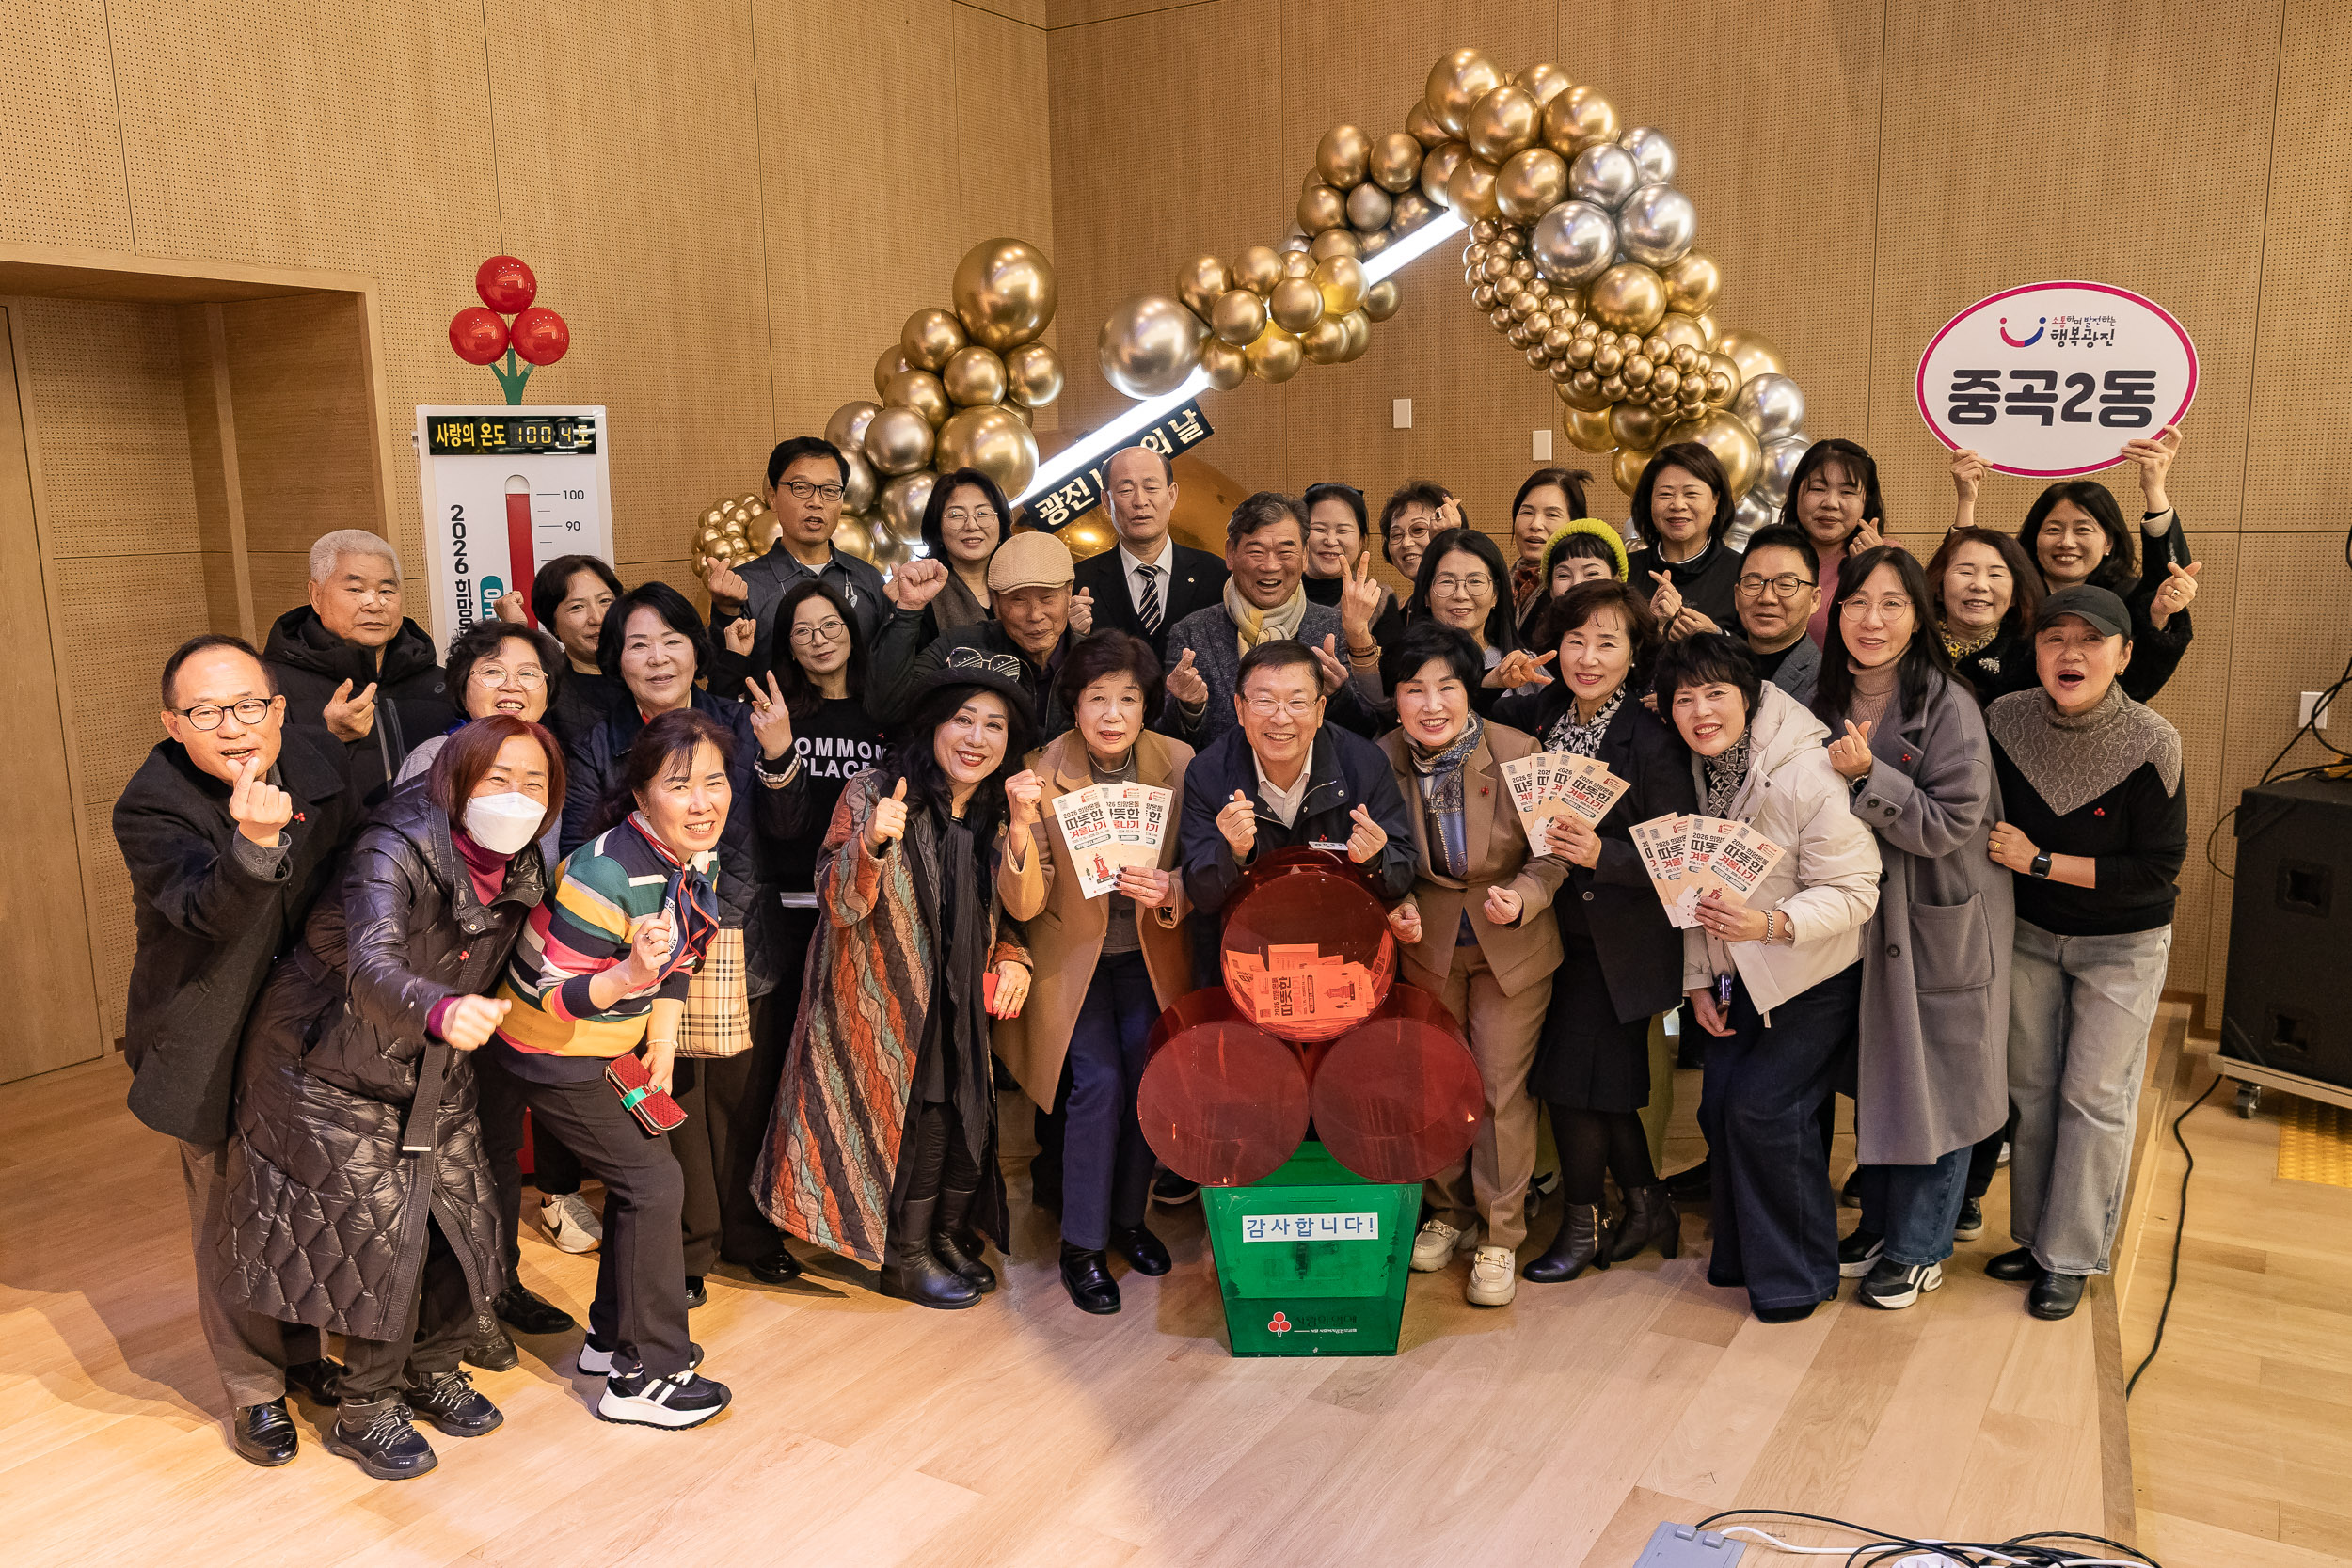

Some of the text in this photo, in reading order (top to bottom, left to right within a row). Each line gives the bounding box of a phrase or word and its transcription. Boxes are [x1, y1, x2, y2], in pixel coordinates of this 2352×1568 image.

[2051, 315, 2116, 328] 소통하며 발전하는
[2050, 326, 2115, 348] 행복광진
[1948, 369, 2156, 428] 중곡2동
[437, 423, 475, 447] 사랑의
[480, 423, 506, 446] 온도
[563, 490, 584, 500] 100
[1035, 477, 1095, 526] 광진
[565, 520, 580, 531] 90
[450, 504, 469, 574] 2026
[794, 737, 886, 761] OMMON
[802, 757, 870, 779] LAC
[1579, 775, 1593, 784] 2026
[1567, 787, 1604, 811] 겨울나기
[1572, 780, 1611, 804] 따뜻한
[1065, 809, 1104, 831] 따뜻한
[1069, 820, 1107, 839] 겨울나기
[1113, 820, 1139, 829] 울나기
[1656, 840, 1670, 848] 2026
[1691, 839, 1718, 854] 따뜻
[1692, 832, 1708, 841] 2026
[1731, 838, 1746, 851] 2026
[1658, 844, 1685, 860] 따뜻
[1724, 844, 1763, 875] 따뜻한
[1718, 853, 1756, 882] 겨울나기
[1279, 976, 1293, 1017] 따뜻한
[1247, 1216, 1374, 1239] 감사합니다!
